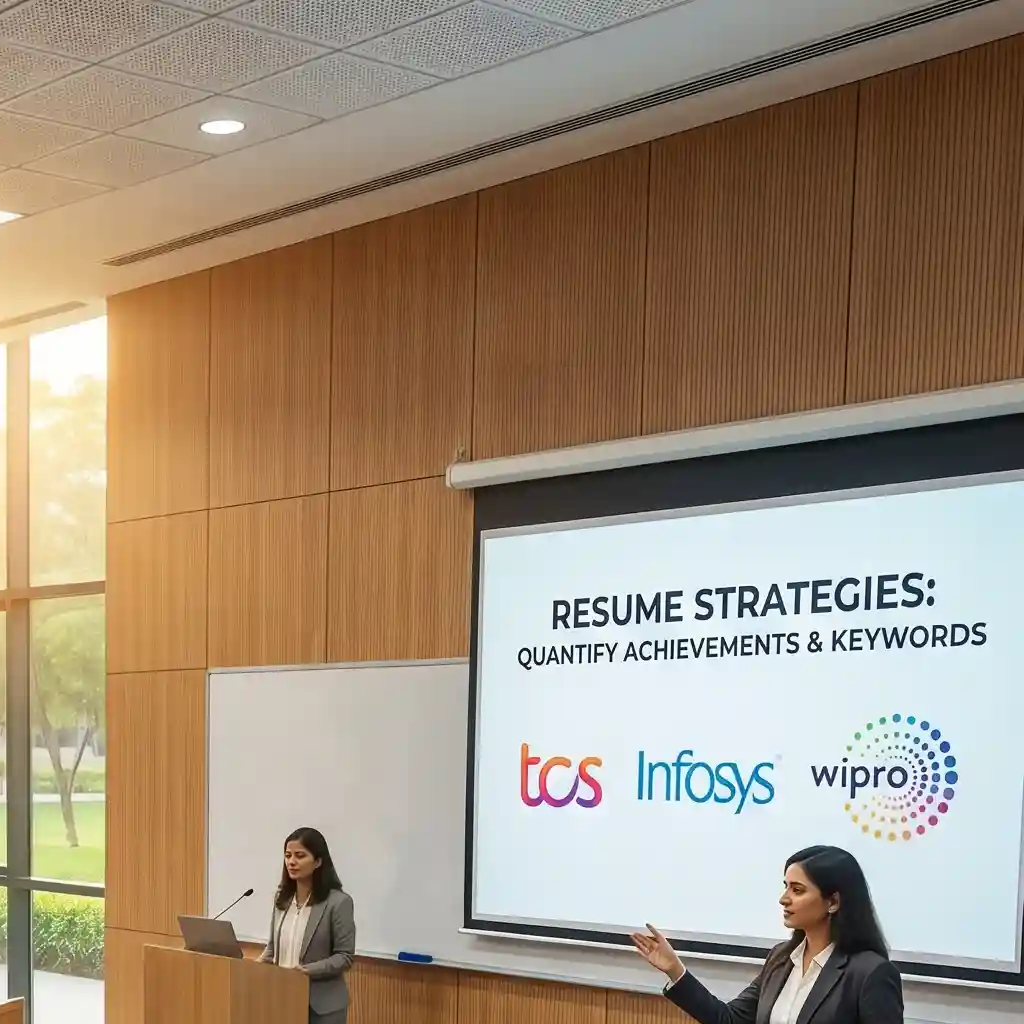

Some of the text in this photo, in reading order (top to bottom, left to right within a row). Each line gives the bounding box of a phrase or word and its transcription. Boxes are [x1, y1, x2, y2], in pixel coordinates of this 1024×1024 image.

[552, 572, 936, 630] RESUME STRATEGIES:
[517, 622, 987, 671] QUANTIFY ACHIEVEMENTS & KEYWORDS
[520, 742, 603, 809] tcs
[636, 749, 776, 815] Infosys
[810, 757, 909, 800] wipro
